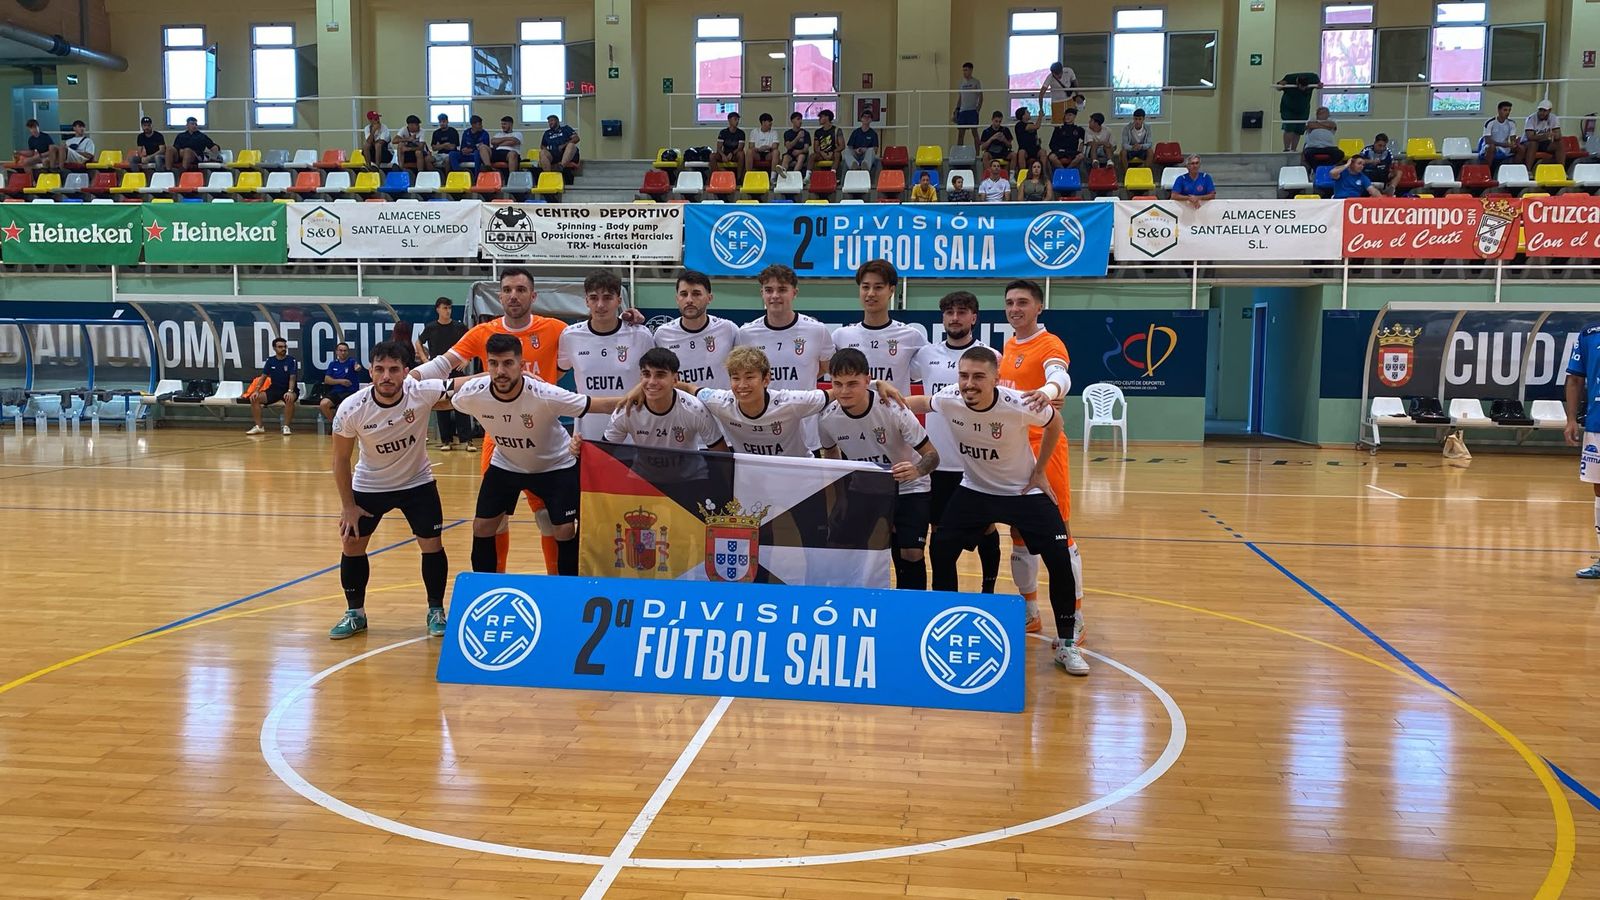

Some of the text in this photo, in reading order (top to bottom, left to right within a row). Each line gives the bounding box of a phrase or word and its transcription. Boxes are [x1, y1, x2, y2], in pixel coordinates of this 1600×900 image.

[378, 211, 441, 220] ALMACENES
[535, 208, 680, 218] CENTRO DEPORTIVO
[1222, 210, 1296, 220] ALMACENES
[1349, 202, 1463, 229] Cruzcampo
[1467, 208, 1476, 226] SIN
[834, 212, 995, 230] DIVISIÓN
[172, 222, 277, 242] Heineken
[352, 224, 468, 235] SANTAELLA Y OLMEDO
[556, 222, 596, 232] Spinning
[606, 222, 630, 232] Body
[632, 224, 659, 232] pump
[1190, 224, 1328, 235] SANTAELLA Y OLMEDO
[29, 223, 133, 243] Heineken
[306, 228, 336, 238] S&O
[541, 231, 594, 241] Oposiciones
[603, 232, 628, 240] Artes
[631, 232, 674, 240] Marciales
[1136, 228, 1171, 238] S&O
[401, 239, 419, 248] S.L.
[593, 241, 648, 250] Musculación
[1248, 240, 1268, 249] S.L.
[1348, 228, 1464, 252] Con el Ceutí
[1527, 232, 1564, 252] Con
[1570, 230, 1589, 247] el
[833, 229, 996, 270] FÚTBOL SALA
[311, 322, 430, 370] CEU
[690, 340, 696, 349] 8
[777, 342, 782, 351] 7
[870, 340, 879, 348] 12
[601, 348, 608, 358] 6
[1445, 331, 1580, 386] CIUDA
[948, 361, 956, 369] 14
[677, 366, 714, 383] CEUTA
[770, 366, 798, 382] EUTA
[870, 367, 894, 381] UTA
[586, 376, 624, 390] CEUTA
[502, 414, 512, 422] 17
[656, 428, 668, 437] 24
[973, 423, 981, 432] 11
[860, 432, 866, 440] 4
[376, 434, 416, 454] CEUTA
[494, 436, 536, 449] CEUTA
[744, 442, 784, 456] CEUTA
[959, 442, 999, 460] CEUTA
[642, 599, 877, 628] DIVISIÓN
[634, 618, 876, 689] FÚTBOL SALA
